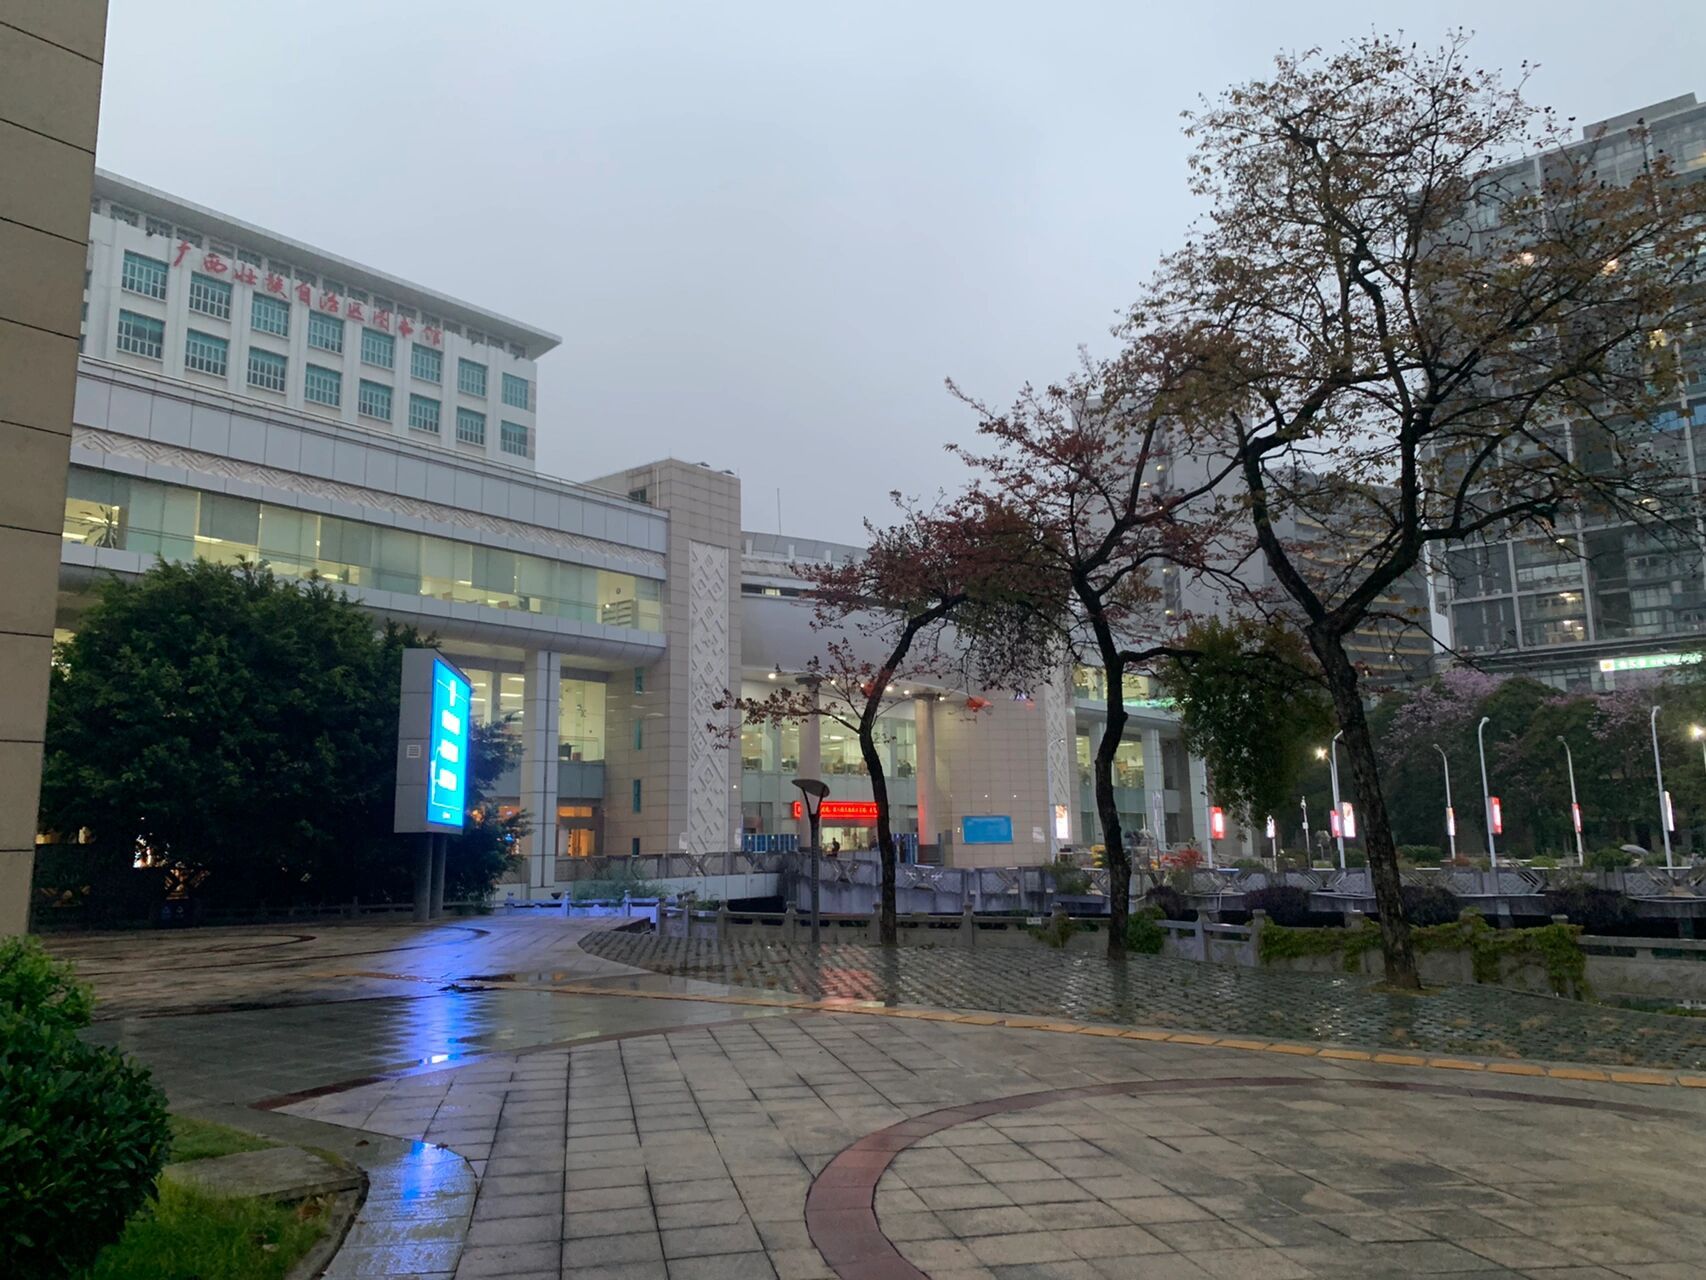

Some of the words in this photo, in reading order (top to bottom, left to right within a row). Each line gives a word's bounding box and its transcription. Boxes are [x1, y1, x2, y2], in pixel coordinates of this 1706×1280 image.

[173, 240, 442, 346] 广西壮族自治区图书馆
